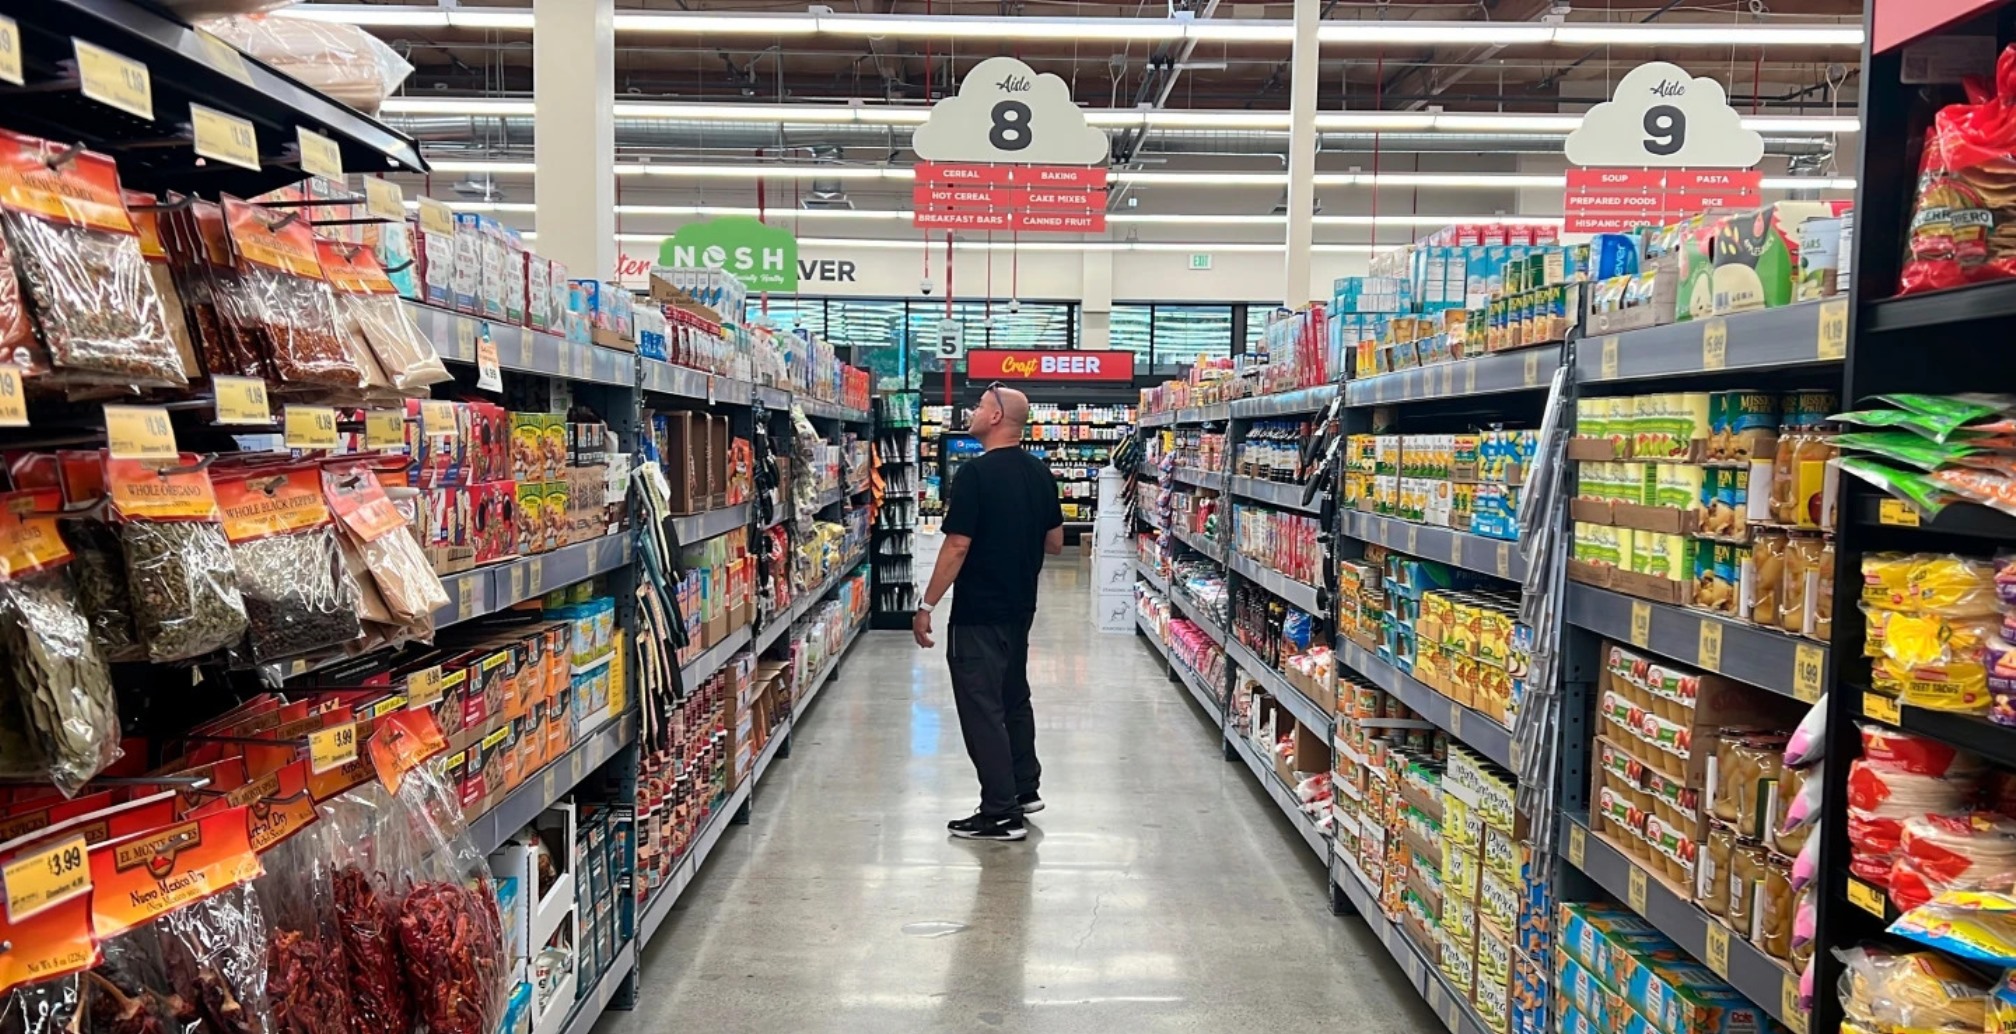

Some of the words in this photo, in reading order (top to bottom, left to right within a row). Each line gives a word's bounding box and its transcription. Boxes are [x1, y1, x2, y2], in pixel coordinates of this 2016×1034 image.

[996, 74, 1031, 92] Aisle
[1650, 79, 1686, 97] Aisle
[989, 100, 1032, 151] 8
[1643, 105, 1686, 155] 9
[943, 169, 980, 178] CEREAL
[1041, 171, 1078, 180] BAKING
[1602, 174, 1628, 183] SOUP
[1696, 175, 1729, 184] PASTA
[932, 192, 952, 200] HOT
[954, 192, 991, 201] CEREAL
[1029, 194, 1055, 202] CAKE
[1057, 195, 1087, 204] MIXES
[1570, 197, 1621, 205] PREPARED
[1623, 197, 1657, 206] FOODS
[1702, 198, 1723, 206] RICE
[918, 214, 974, 223] BREAKFAST
[977, 215, 1003, 224] BARS
[1023, 216, 1062, 226] CANNED
[1064, 217, 1092, 226] FRUIT
[1575, 219, 1620, 228] HISPANIC
[1623, 220, 1650, 229] FOOD
[617, 253, 651, 275] ter
[674, 245, 783, 271] NOSH
[1193, 255, 1209, 267] EXIT
[941, 336, 956, 355] 5
[1002, 355, 1039, 377] Craft
[1041, 356, 1100, 373] BEER
[127, 484, 159, 496] WHOLE
[226, 504, 261, 518] WHOLE
[261, 500, 289, 513] BLACK
[120, 851, 131, 863] EL
[133, 838, 166, 858] MONTE
[48, 846, 81, 876] $3.99
[130, 889, 158, 908] Nuevo
[157, 877, 190, 896] Mexico
